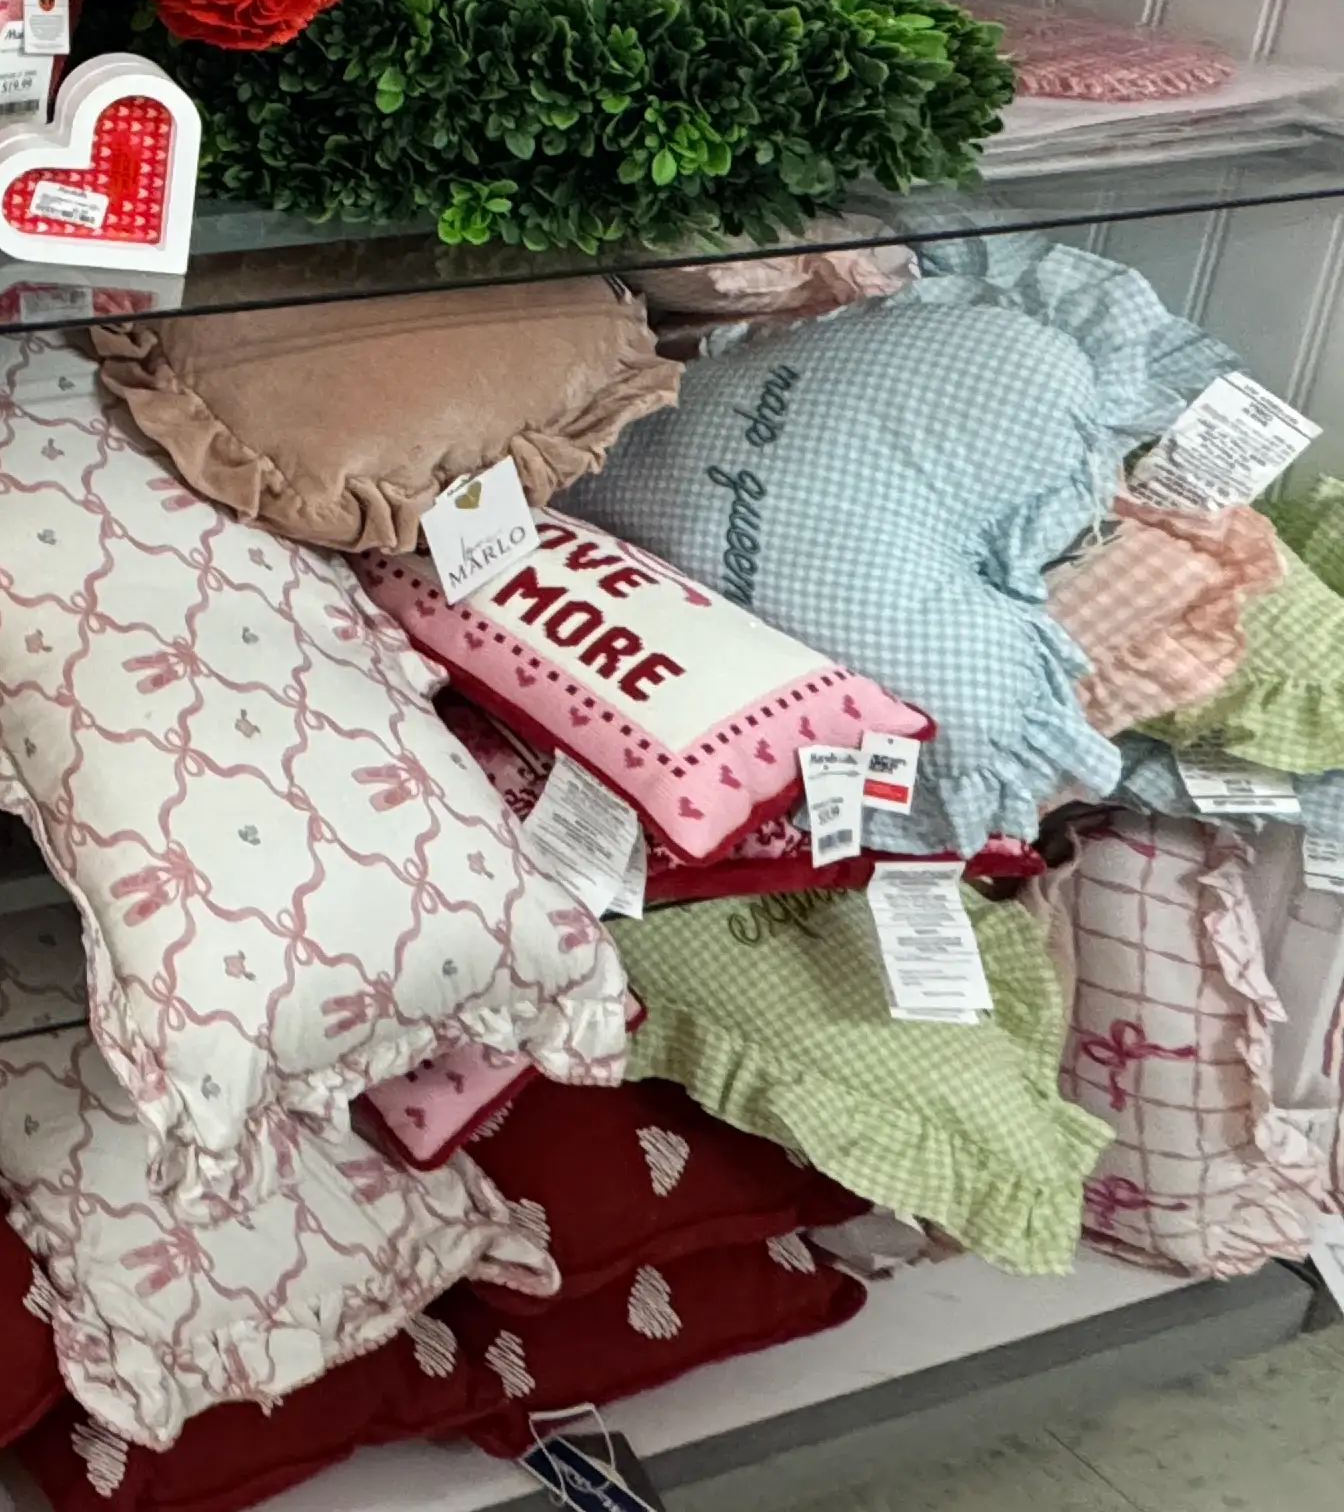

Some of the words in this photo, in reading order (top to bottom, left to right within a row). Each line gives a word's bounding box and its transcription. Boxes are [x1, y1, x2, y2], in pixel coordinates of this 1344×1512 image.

[733, 364, 801, 448] nap
[448, 525, 526, 590] MARLO
[535, 522, 660, 599] OVE
[707, 464, 768, 607] queen
[491, 565, 687, 702] MORE
